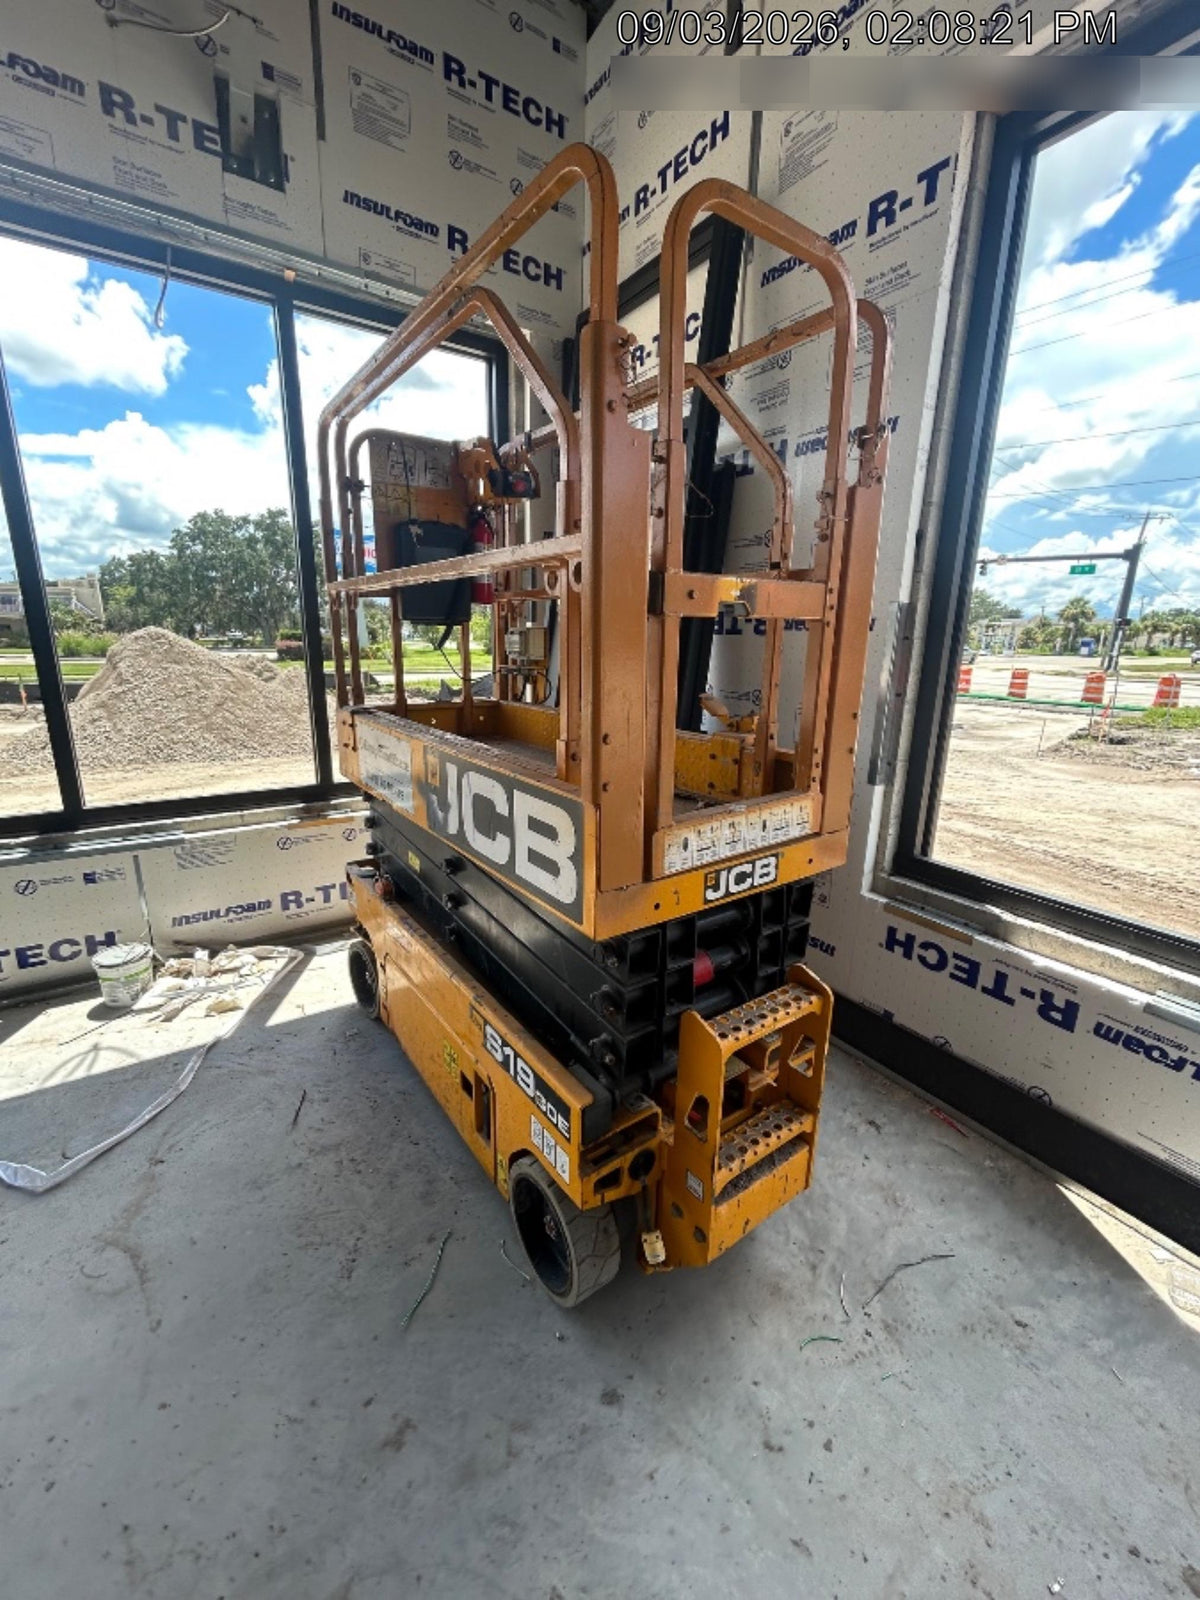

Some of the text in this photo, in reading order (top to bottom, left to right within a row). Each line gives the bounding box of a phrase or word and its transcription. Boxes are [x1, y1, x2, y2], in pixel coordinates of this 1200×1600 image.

[443, 51, 566, 139] R-TECH
[634, 111, 730, 217] R-TECH
[866, 155, 958, 238] R-T
[447, 224, 564, 291] RECH
[428, 762, 577, 904] JCB
[705, 858, 777, 900] JCB
[884, 925, 1081, 1034] R-TECH
